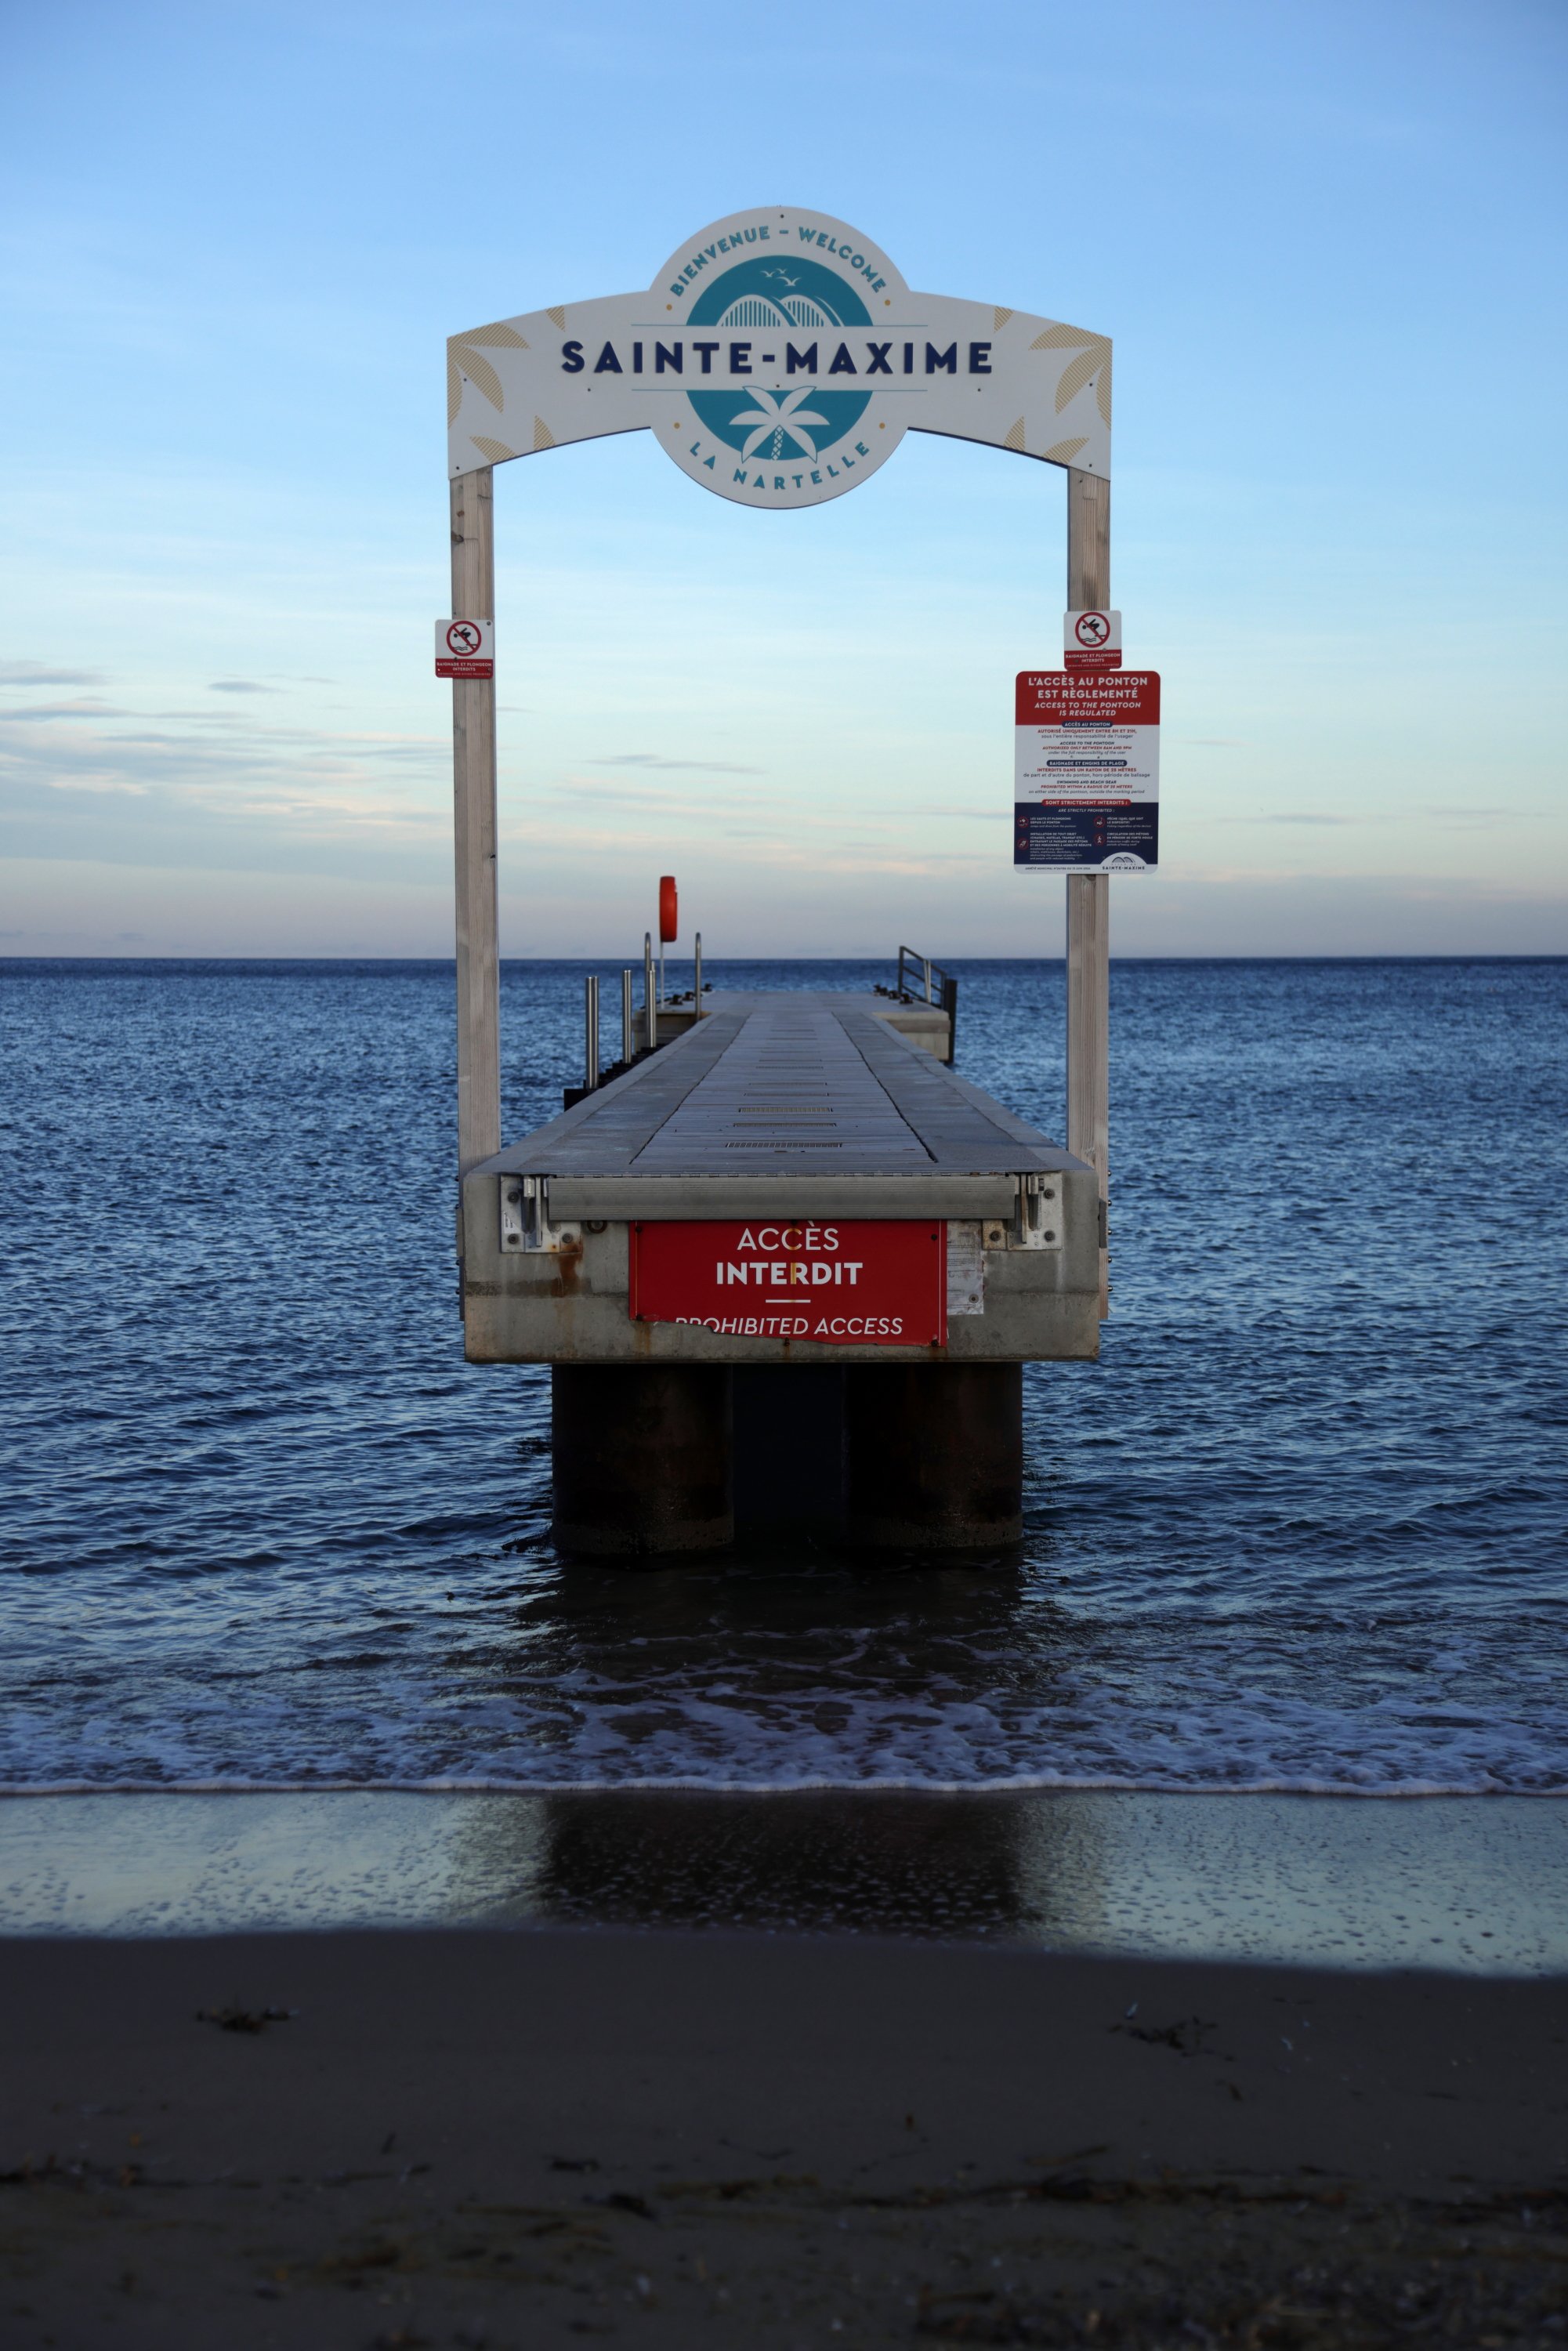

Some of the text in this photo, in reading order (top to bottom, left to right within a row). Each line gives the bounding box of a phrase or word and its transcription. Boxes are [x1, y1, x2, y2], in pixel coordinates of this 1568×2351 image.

[670, 226, 770, 296] BIENVENUE
[799, 226, 886, 293] WELCOME
[561, 341, 993, 375] SAINTE-MAXIME
[690, 441, 870, 490] LA NARTELLE
[1028, 675, 1147, 686] L'ACCÈS AU PONTON
[1037, 687, 1138, 698] EST RÈGLEMENTÉ
[737, 1220, 839, 1251] ACCÈS
[716, 1262, 863, 1284] INTERDIT
[813, 1317, 904, 1335] ACCESS
